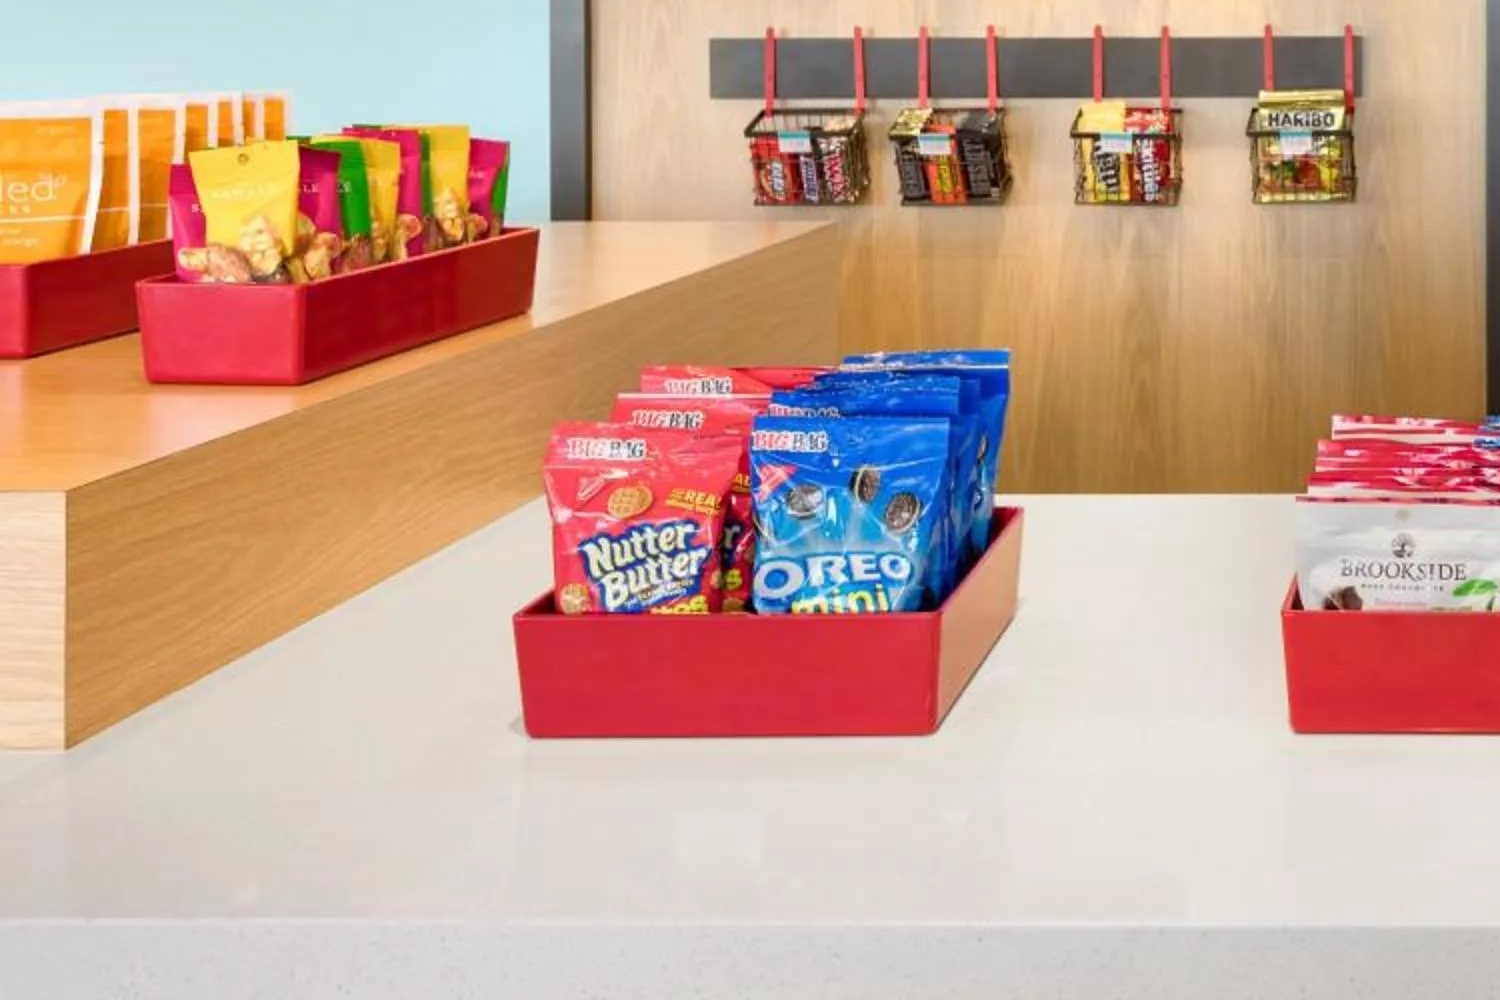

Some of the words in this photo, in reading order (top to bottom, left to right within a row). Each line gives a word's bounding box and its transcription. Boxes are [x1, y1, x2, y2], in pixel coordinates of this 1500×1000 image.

[1267, 110, 1336, 128] HARIBO
[668, 411, 703, 428] BAG
[567, 438, 605, 459] BIG
[608, 439, 647, 460] BAG
[753, 431, 790, 450] BIG
[792, 430, 829, 450] BAG
[578, 523, 699, 578] Nutter
[601, 548, 710, 610] Butter
[754, 553, 911, 598] OREO
[1340, 559, 1468, 583] BROOKSIDE
[791, 584, 890, 613] mini
